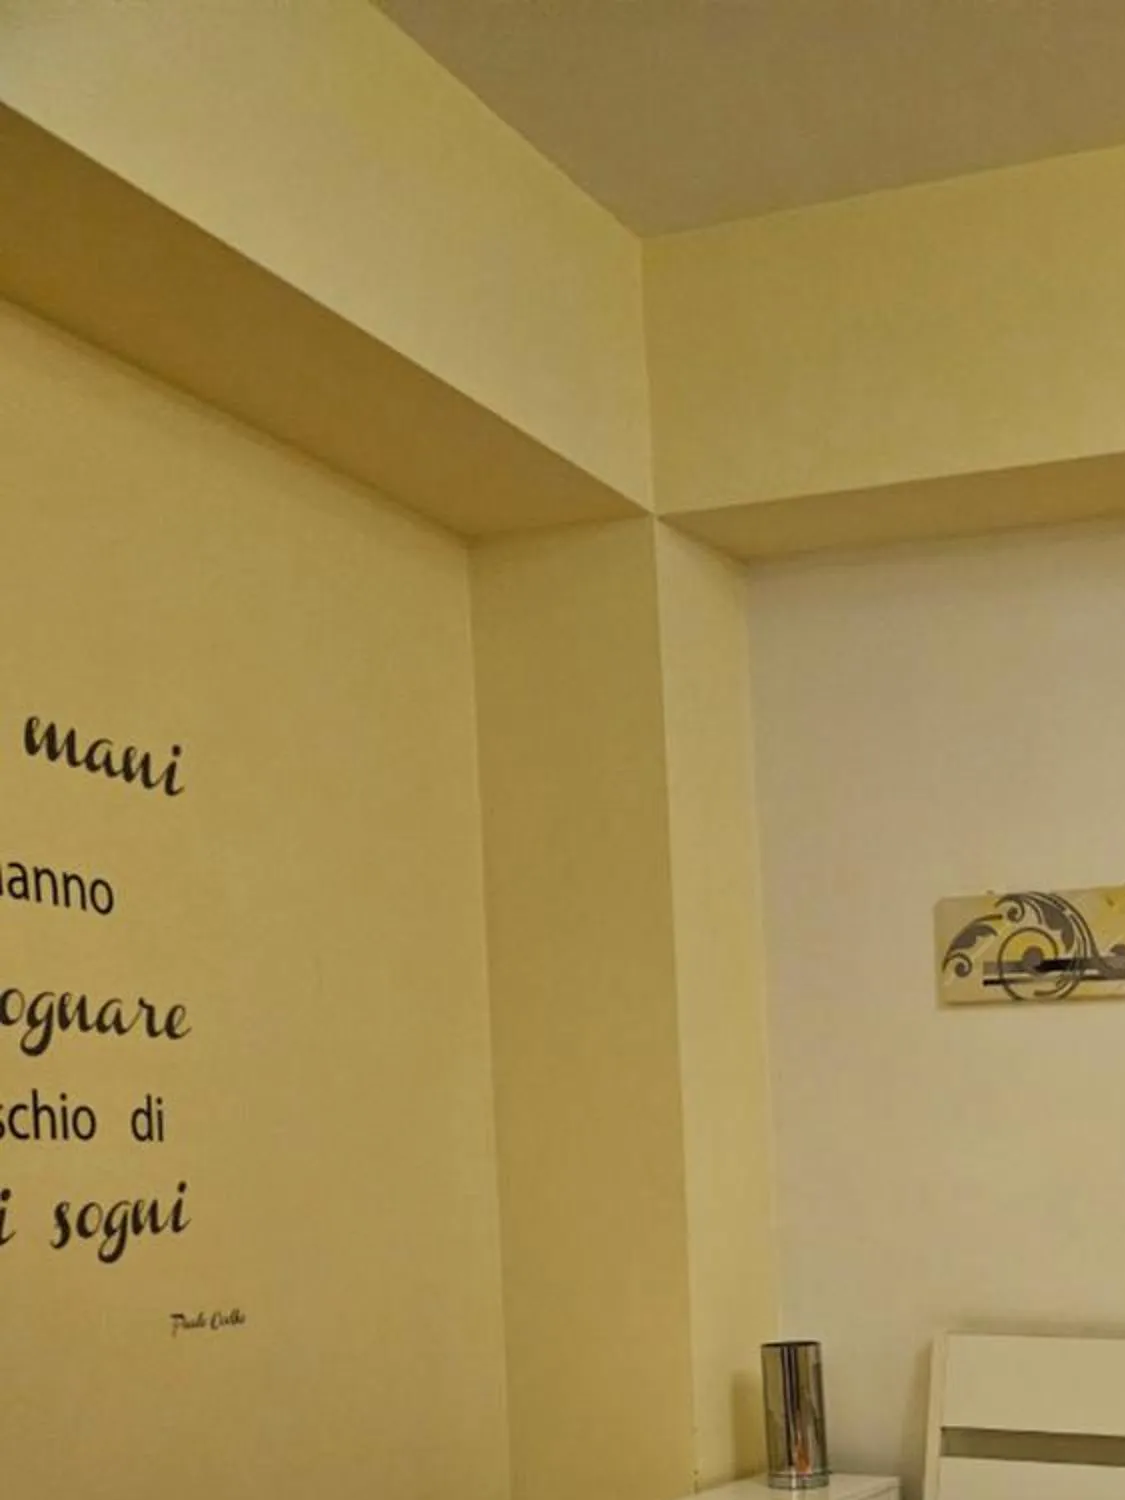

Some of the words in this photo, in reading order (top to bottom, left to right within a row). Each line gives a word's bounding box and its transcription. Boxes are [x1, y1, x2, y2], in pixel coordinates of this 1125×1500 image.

[24, 715, 185, 797] mani
[0, 861, 115, 916] anno
[0, 1087, 98, 1142] chio
[130, 1092, 165, 1143] di
[50, 1180, 191, 1265] sogni
